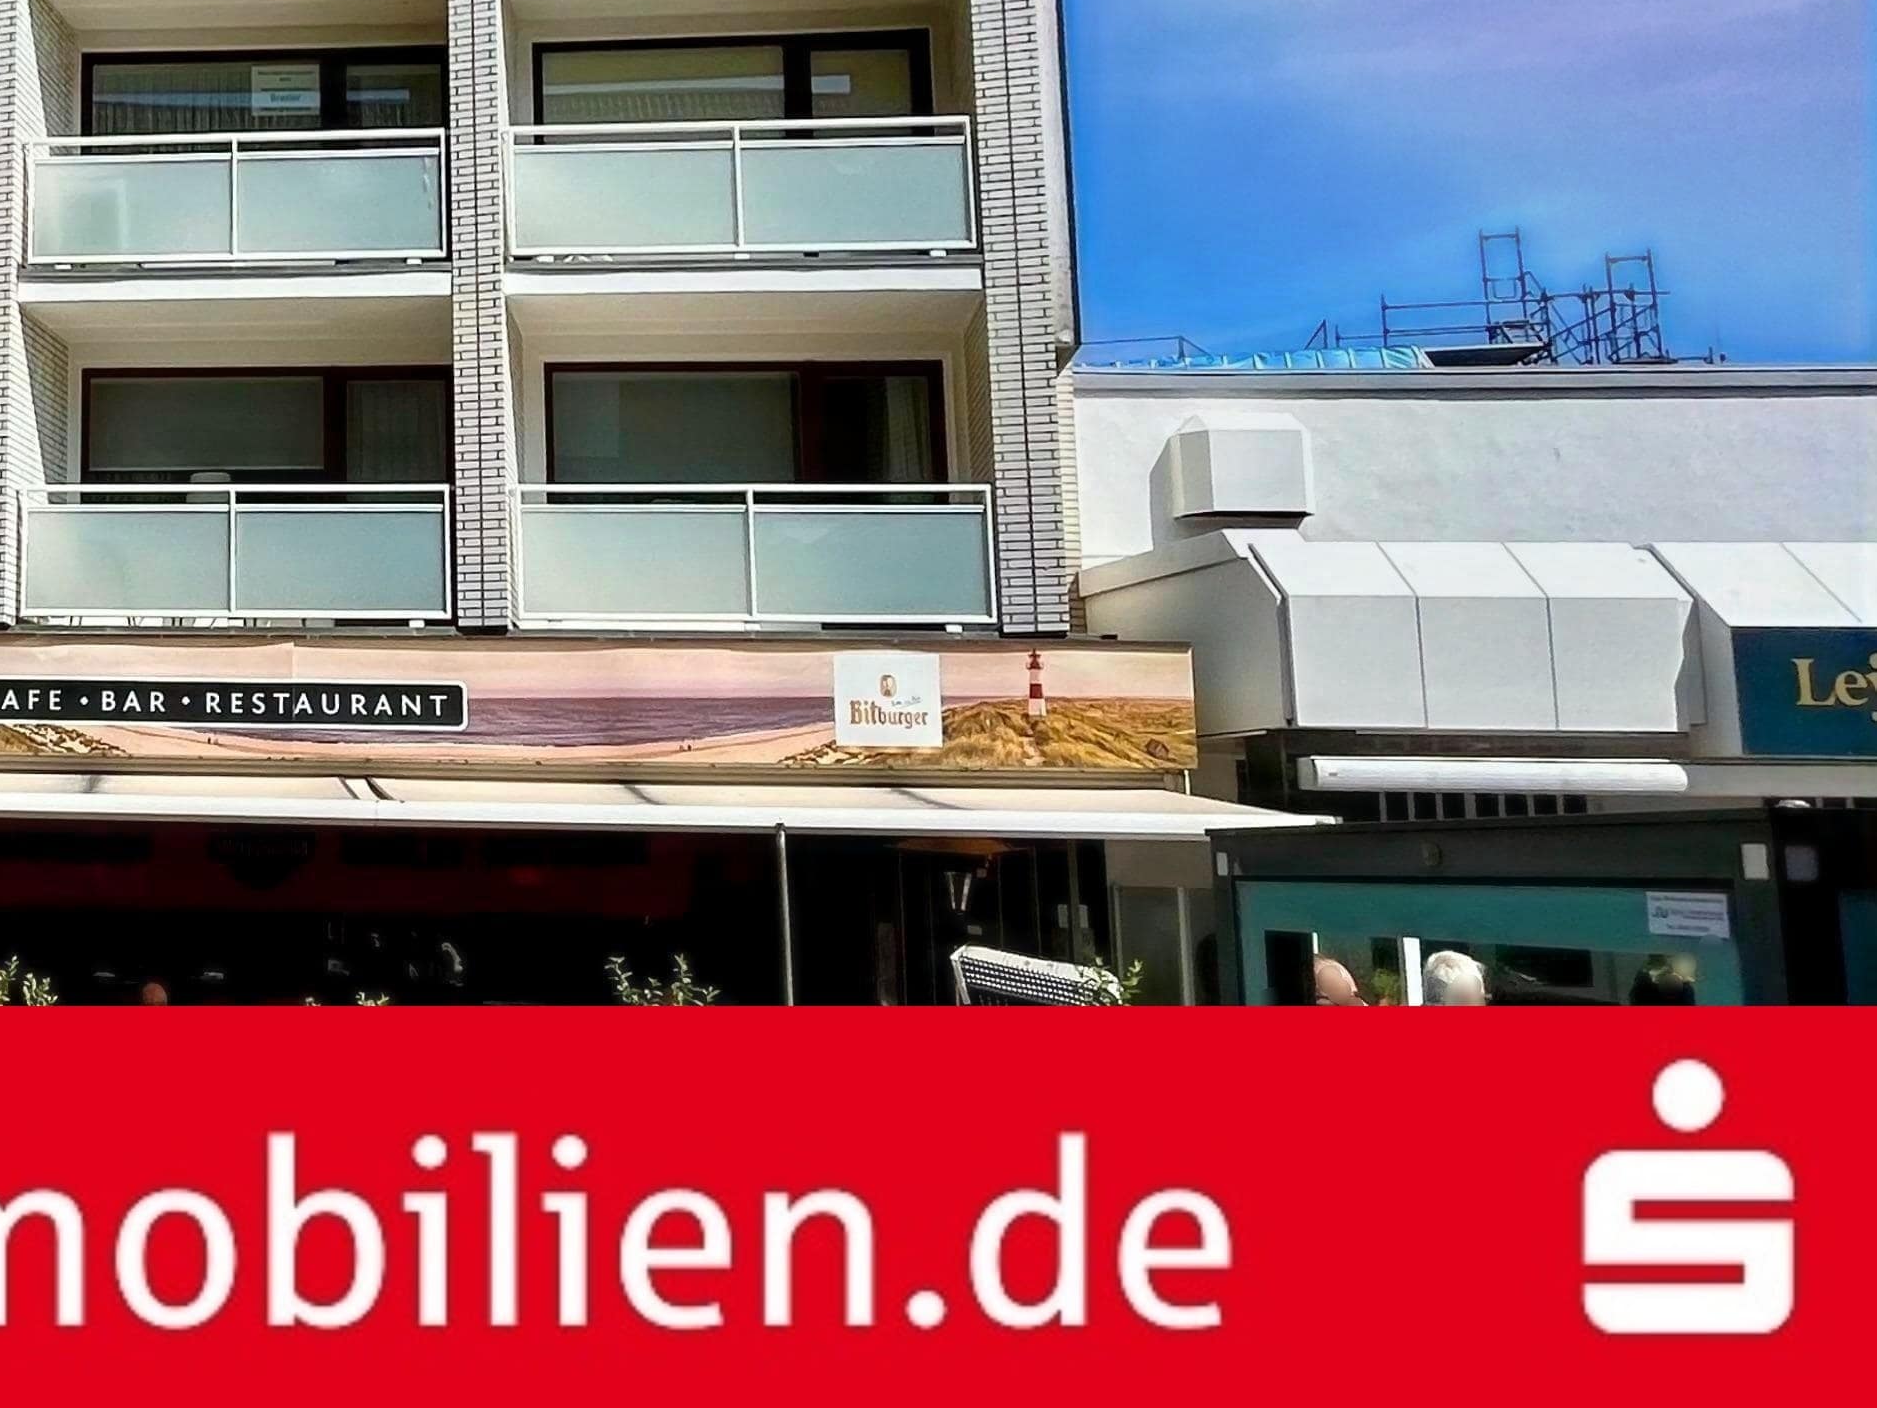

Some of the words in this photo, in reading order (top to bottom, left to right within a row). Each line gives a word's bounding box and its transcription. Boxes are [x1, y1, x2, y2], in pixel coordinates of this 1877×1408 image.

[101, 690, 166, 713] BAR
[206, 692, 448, 717] RESTAURANT
[849, 699, 929, 730] Bitburger
